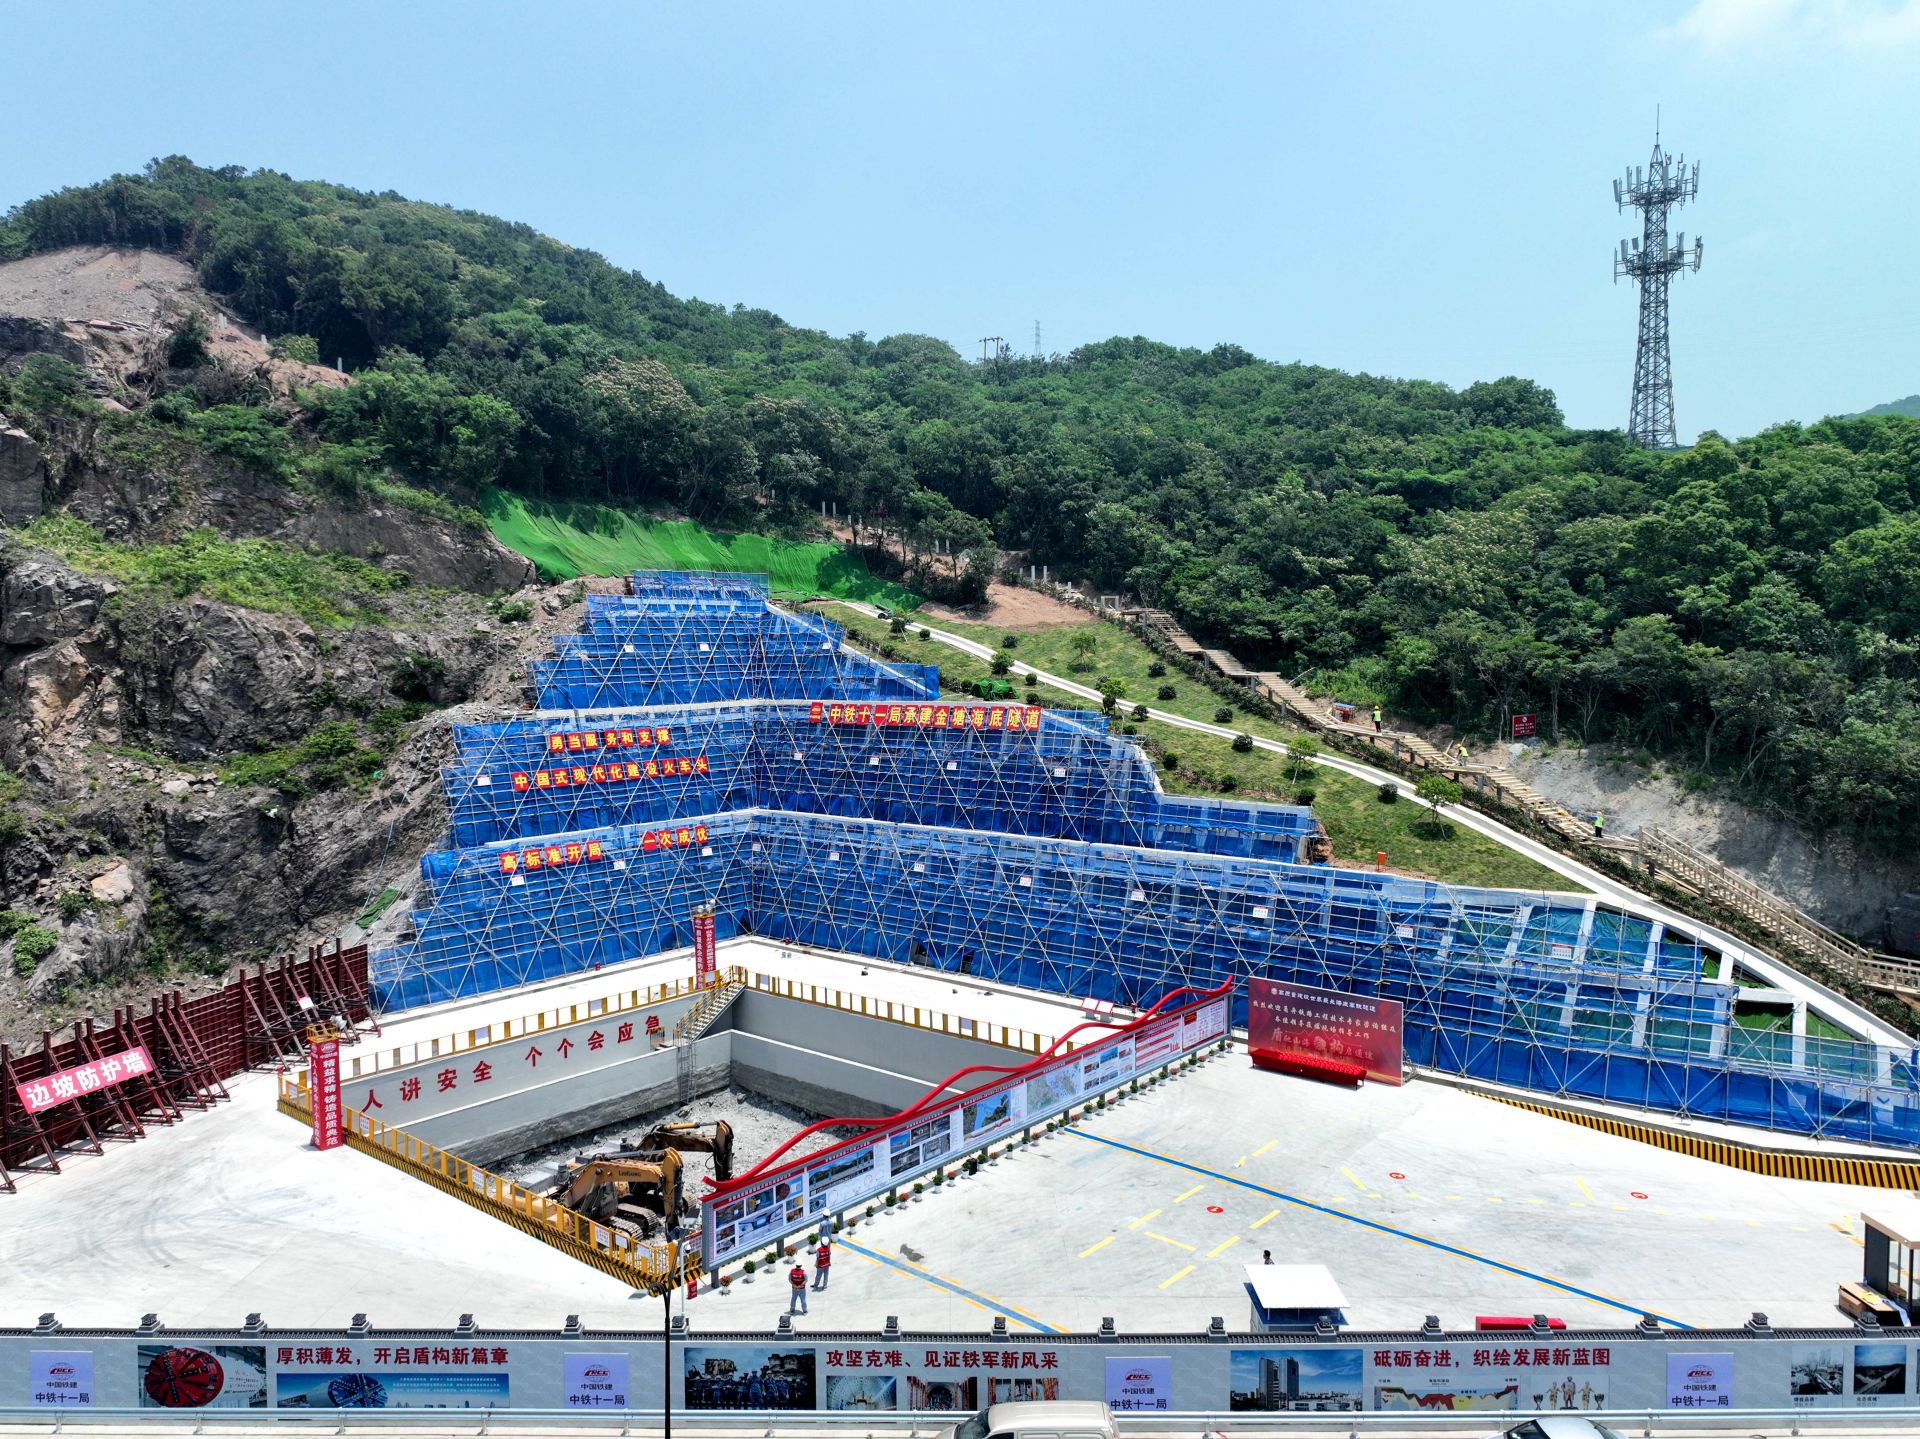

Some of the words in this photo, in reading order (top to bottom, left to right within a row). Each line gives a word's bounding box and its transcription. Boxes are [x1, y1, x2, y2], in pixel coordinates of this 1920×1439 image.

[829, 704, 1041, 729] 中铁十一局承建金塘海底隧道
[551, 729, 670, 750] 勇当服务和支撑
[514, 757, 708, 789] 中国式现代化建设火车头
[503, 843, 602, 870] 高标准开局
[644, 828, 708, 846] 一次成优
[525, 1015, 662, 1067] 个个会应急
[25, 1051, 147, 1109] 边坡防护墙
[323, 1059, 337, 1094] 精益求精
[35, 1392, 90, 1403] 中铁十一局
[569, 1394, 625, 1405] 中铁十一局
[1110, 1399, 1167, 1410] 中铁十一局
[1671, 1395, 1729, 1406] 中铁十一局
